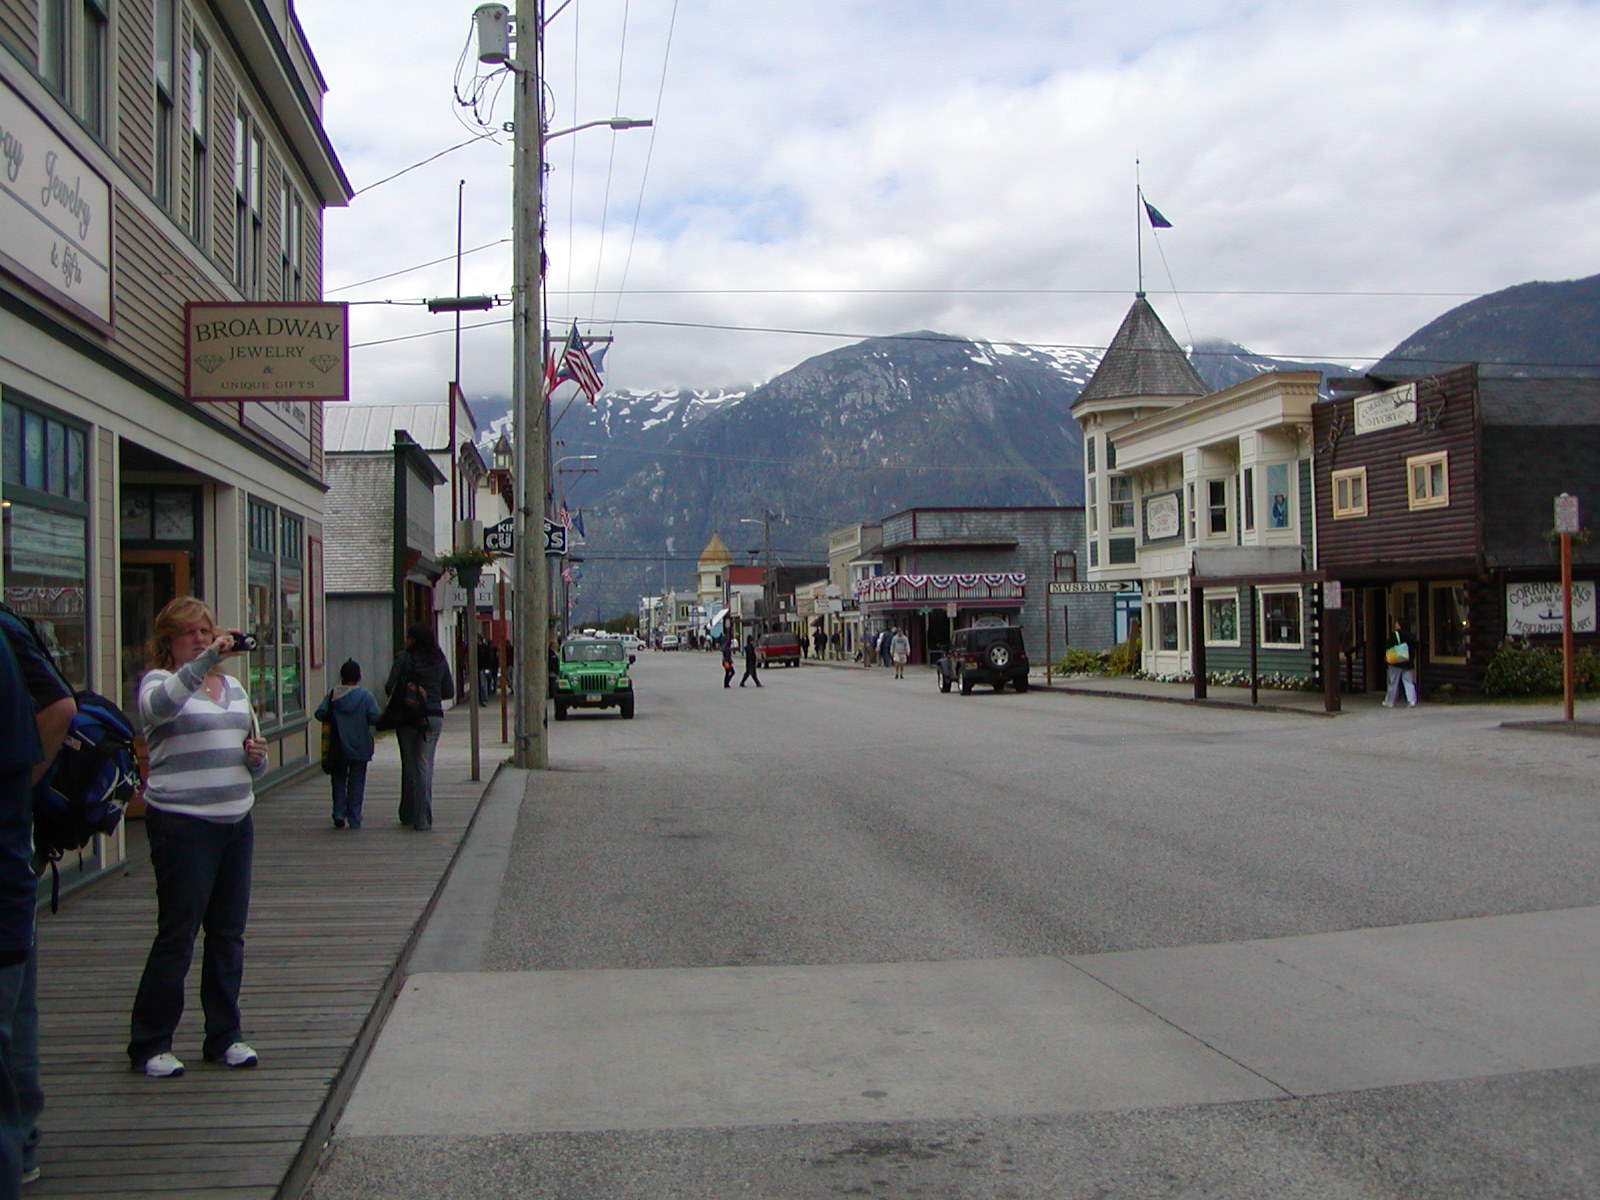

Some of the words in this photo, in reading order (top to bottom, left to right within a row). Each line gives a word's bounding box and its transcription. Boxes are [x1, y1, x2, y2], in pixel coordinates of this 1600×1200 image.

[42, 150, 91, 241] Jewelry
[195, 317, 340, 342] BROADWAY
[229, 346, 305, 360] JEWELRY
[263, 365, 273, 374] &
[221, 381, 269, 391] UNIQUE
[275, 380, 315, 389] GIFTS
[486, 532, 564, 549] CUOS
[1052, 583, 1108, 592] MUSEUM
[1509, 582, 1591, 605] CORRINGONS
